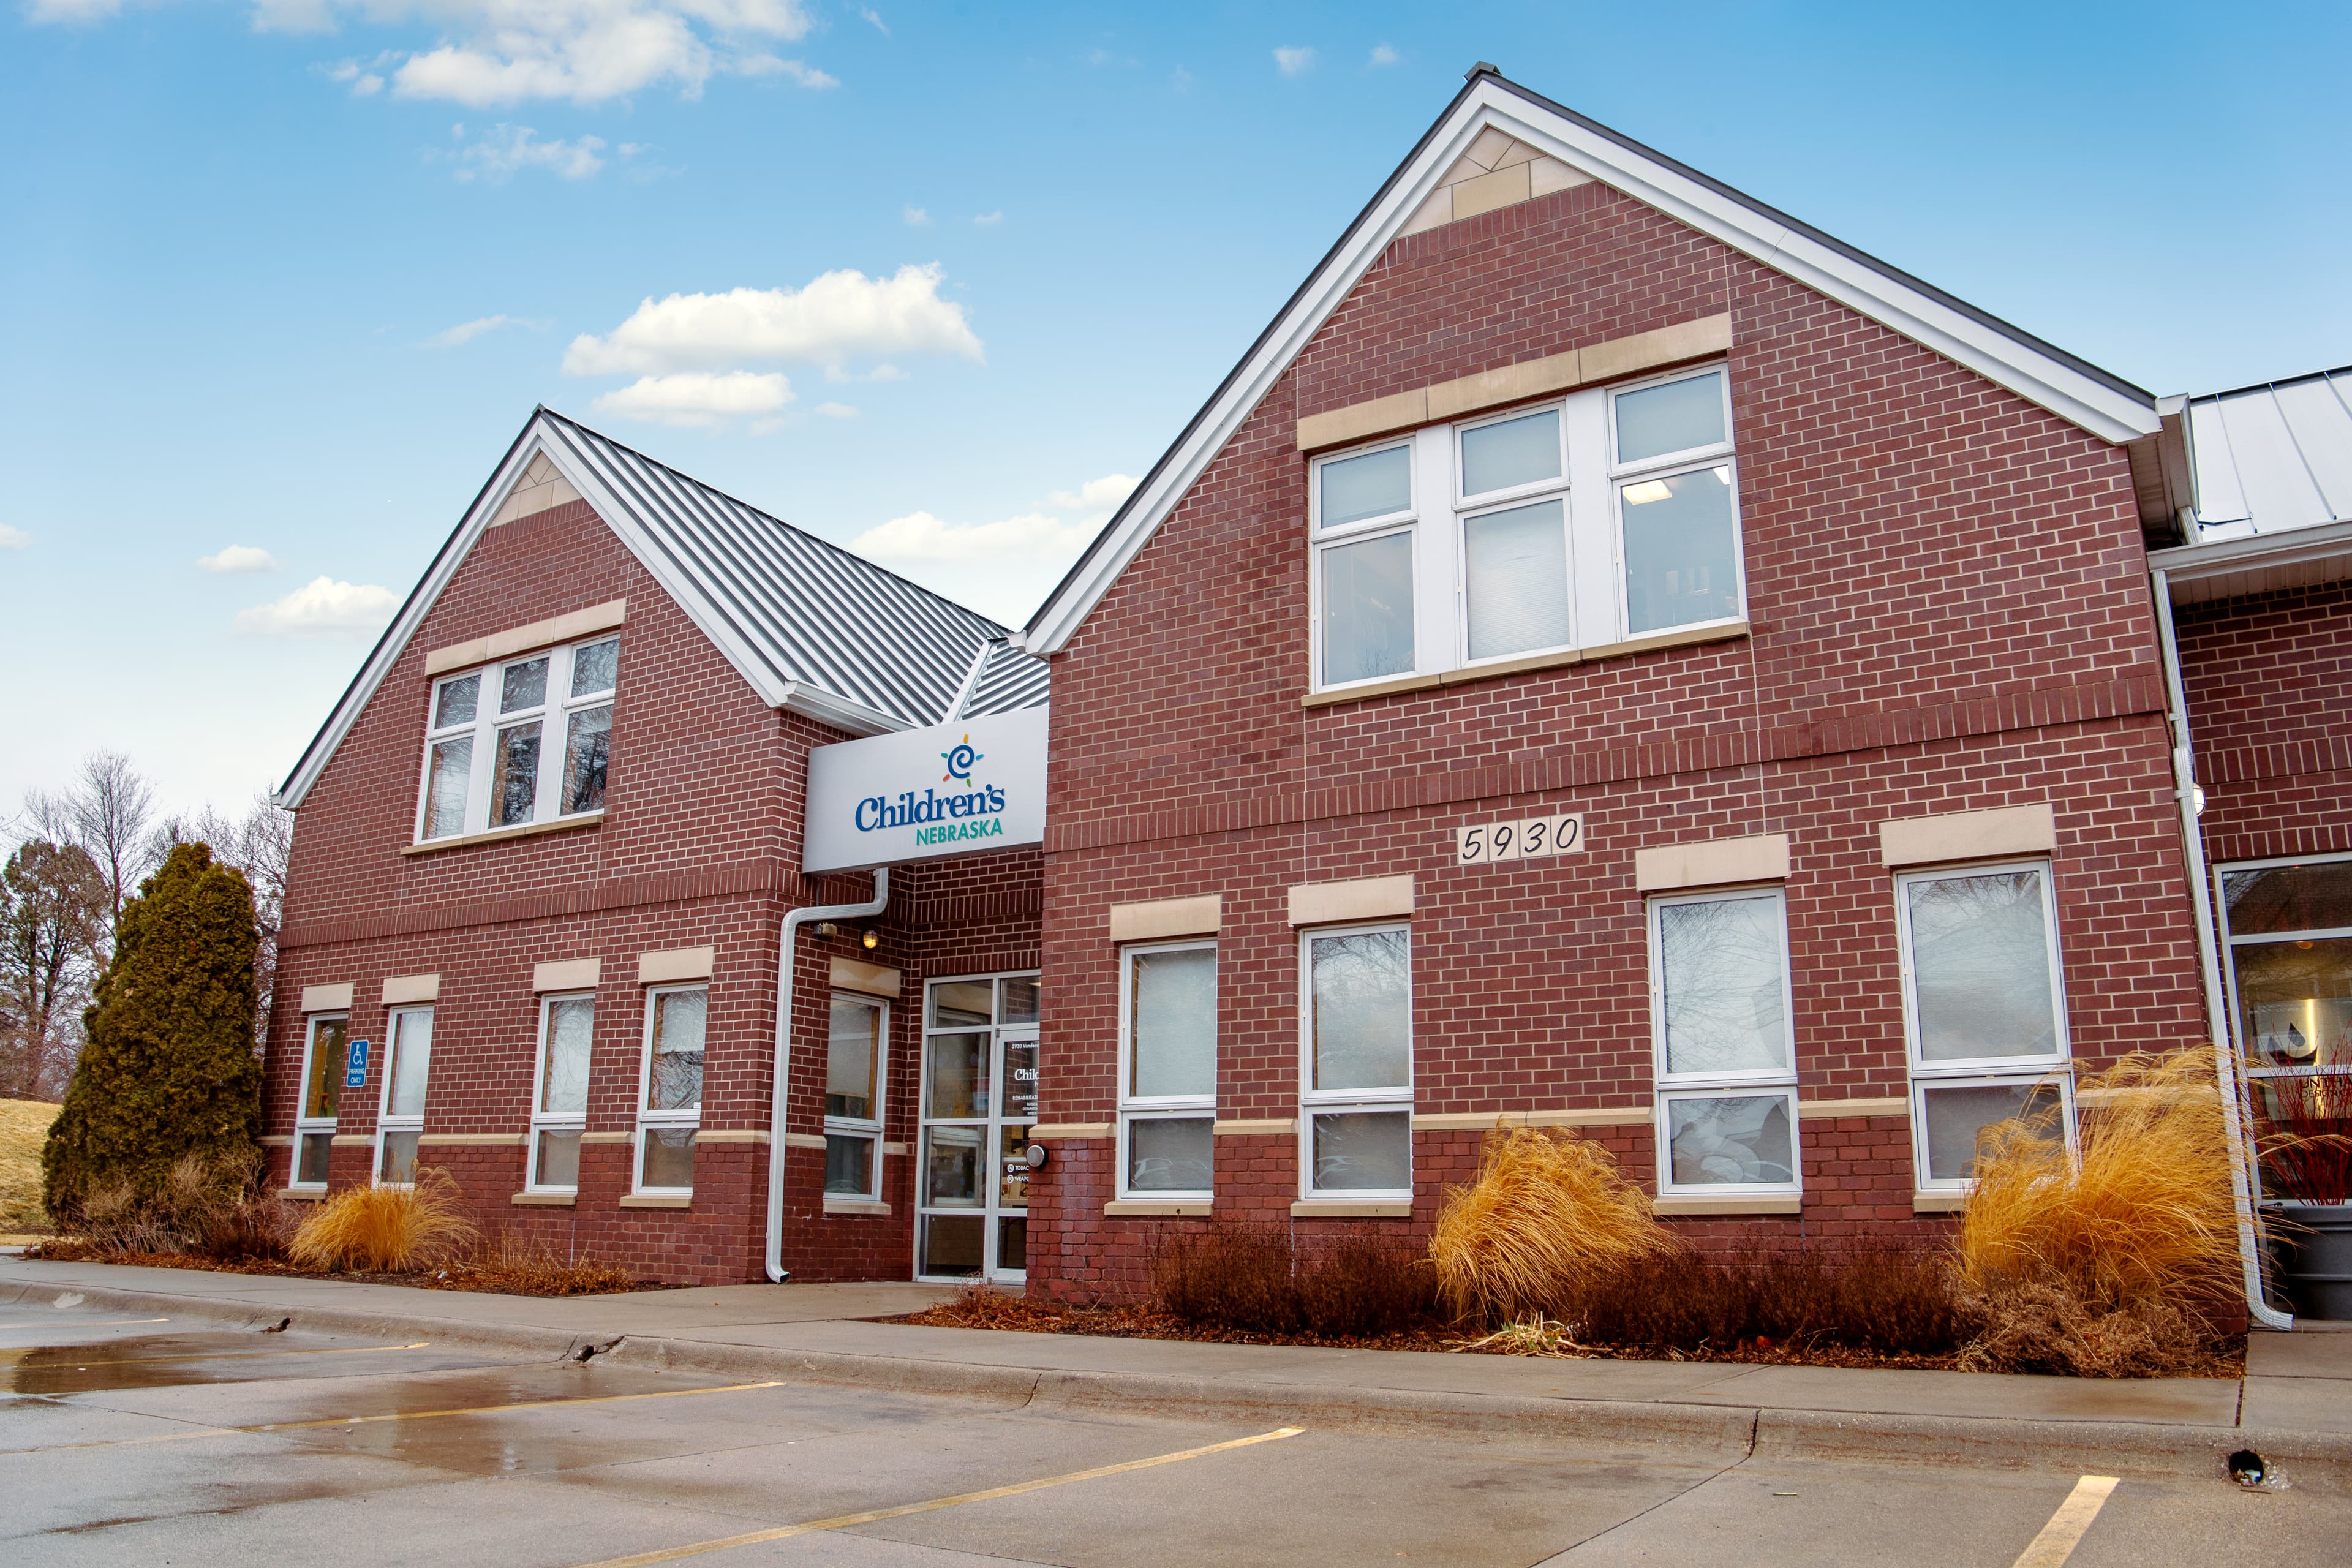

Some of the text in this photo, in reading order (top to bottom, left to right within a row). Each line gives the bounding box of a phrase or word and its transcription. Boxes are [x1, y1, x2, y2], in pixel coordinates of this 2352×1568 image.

[856, 783, 1005, 832] Children's
[916, 818, 1003, 846] NEBRASKA
[1462, 818, 1578, 860] 5930
